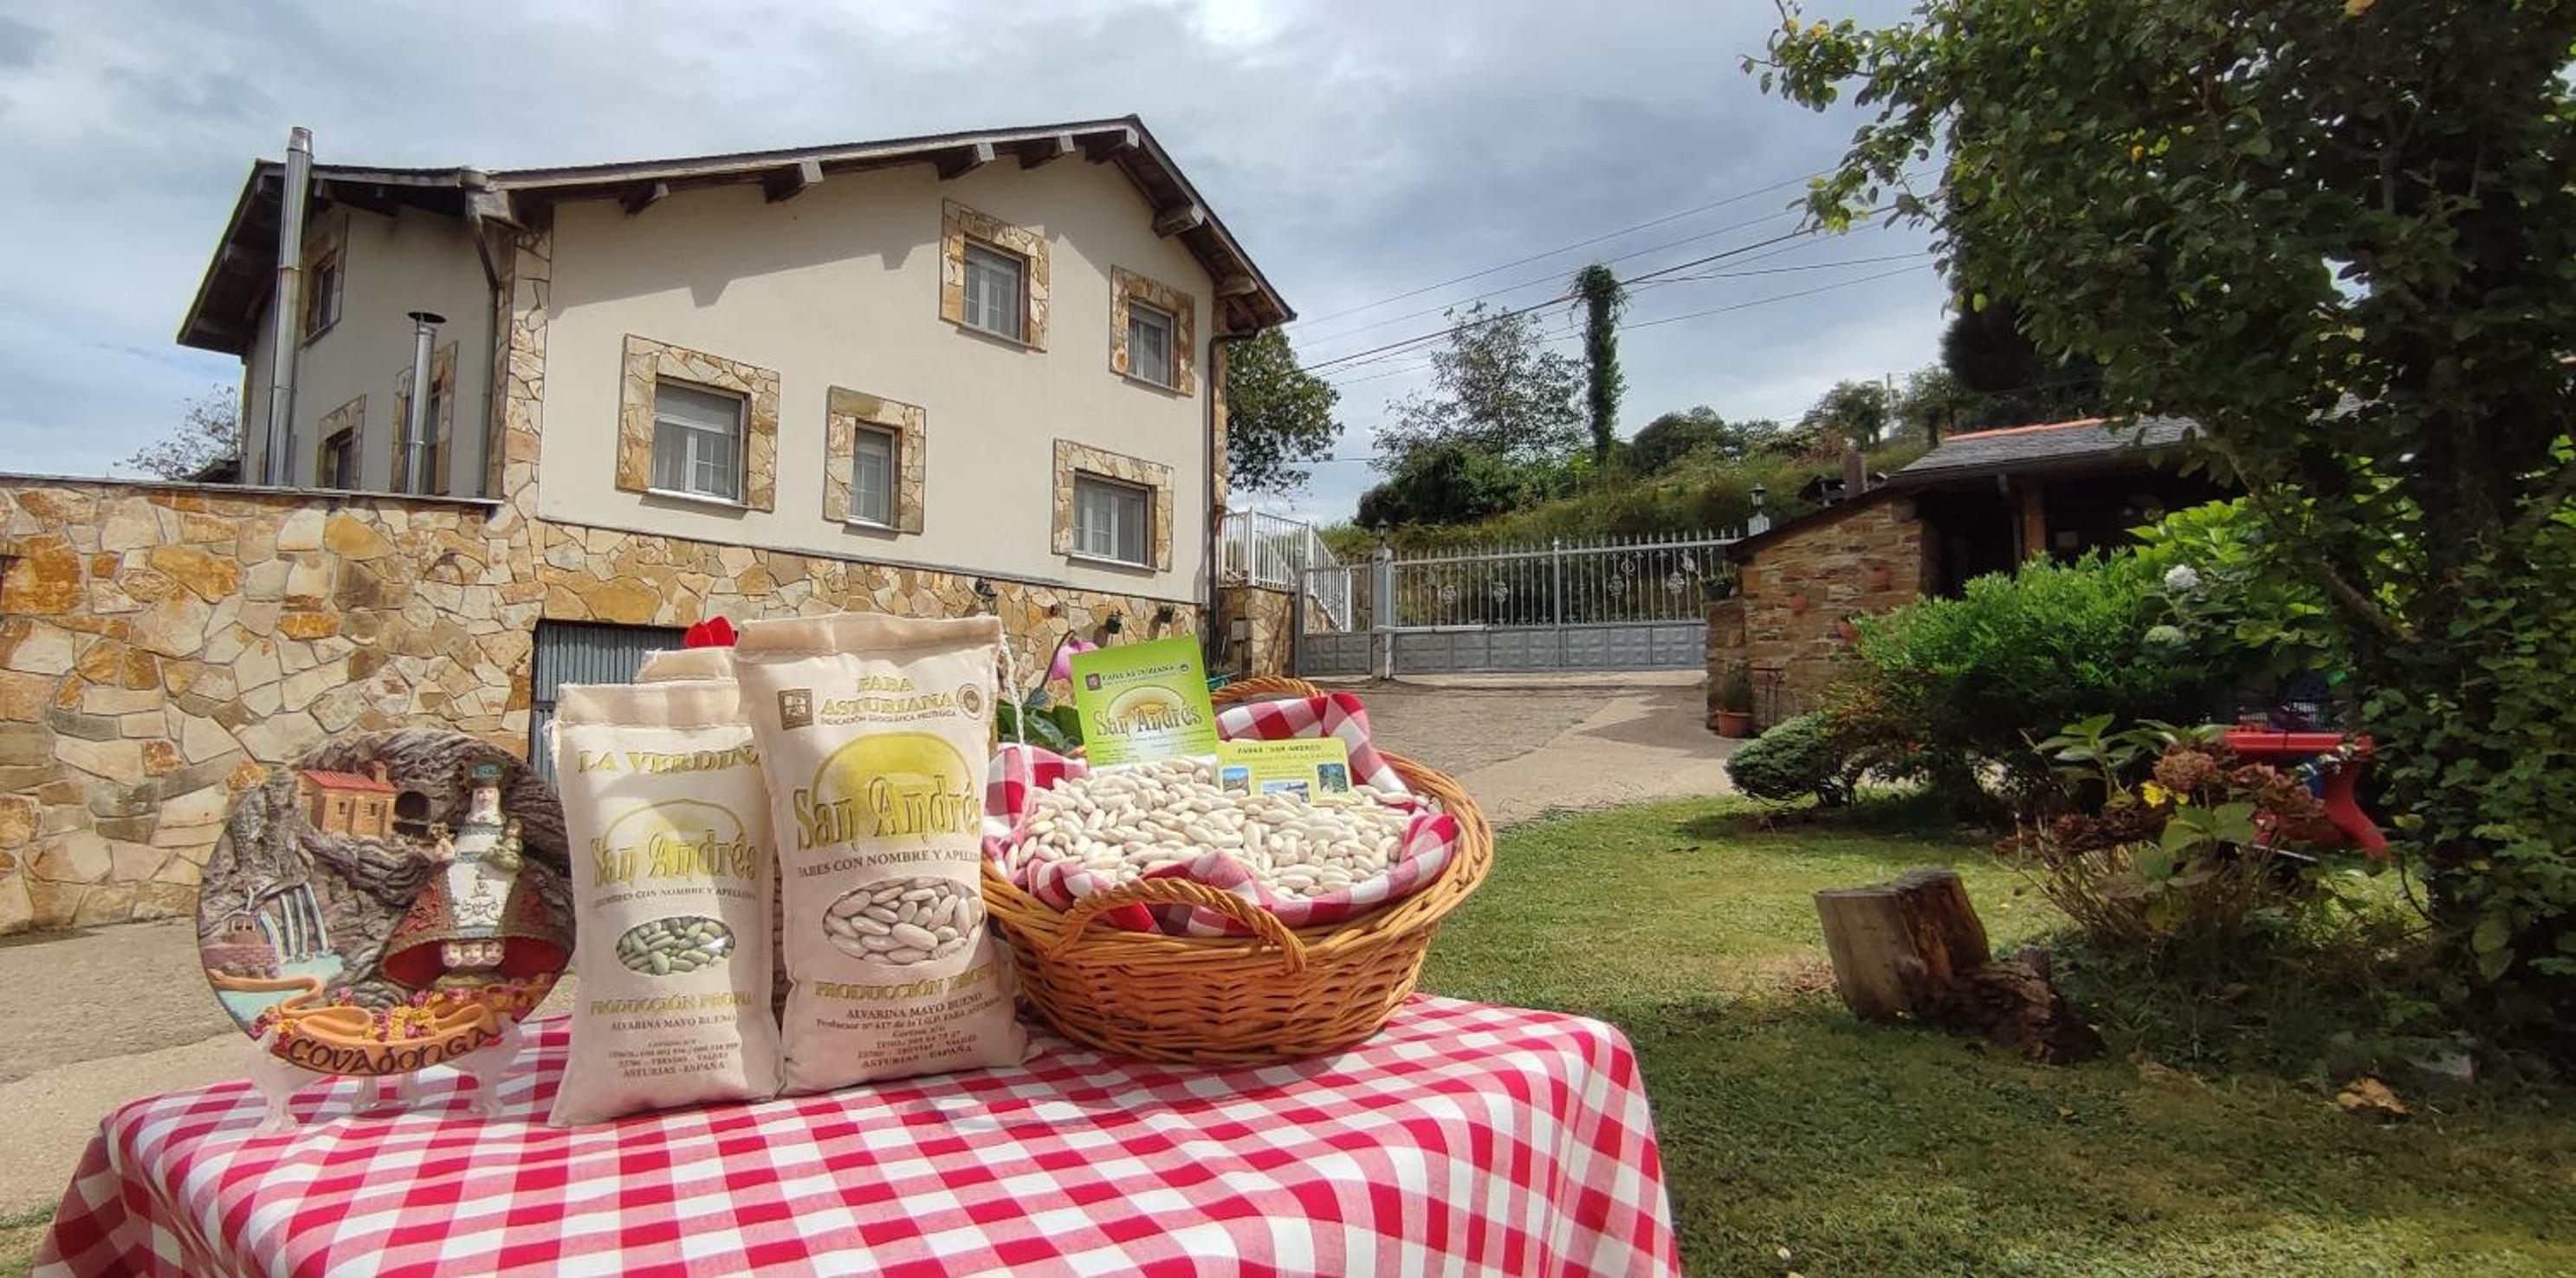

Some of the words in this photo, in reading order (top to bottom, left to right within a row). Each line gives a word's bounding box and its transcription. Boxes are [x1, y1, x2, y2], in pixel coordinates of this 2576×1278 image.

[858, 675, 915, 692] FABA
[821, 693, 953, 715] ASTURIANA
[1094, 711, 1130, 738] San
[1133, 702, 1202, 732] Andrés
[579, 750, 618, 773] LA
[793, 788, 858, 852] San
[591, 838, 634, 888] San
[649, 829, 756, 881] Andrés
[834, 858, 863, 872] CON
[867, 852, 930, 866] NOMBRE
[933, 850, 942, 860] Y
[815, 977, 944, 1000] PRODUCCIÓN
[846, 1008, 906, 1020] ALVARINA
[909, 1003, 945, 1016] MAYO
[948, 991, 983, 1007] BUENO
[611, 1020, 663, 1031] ALVARINA
[663, 1017, 696, 1029] MAYO
[862, 1054, 919, 1067] ASTURIAS
[929, 1045, 973, 1060] ESPAÑA
[623, 1065, 676, 1079] ASTURIAS
